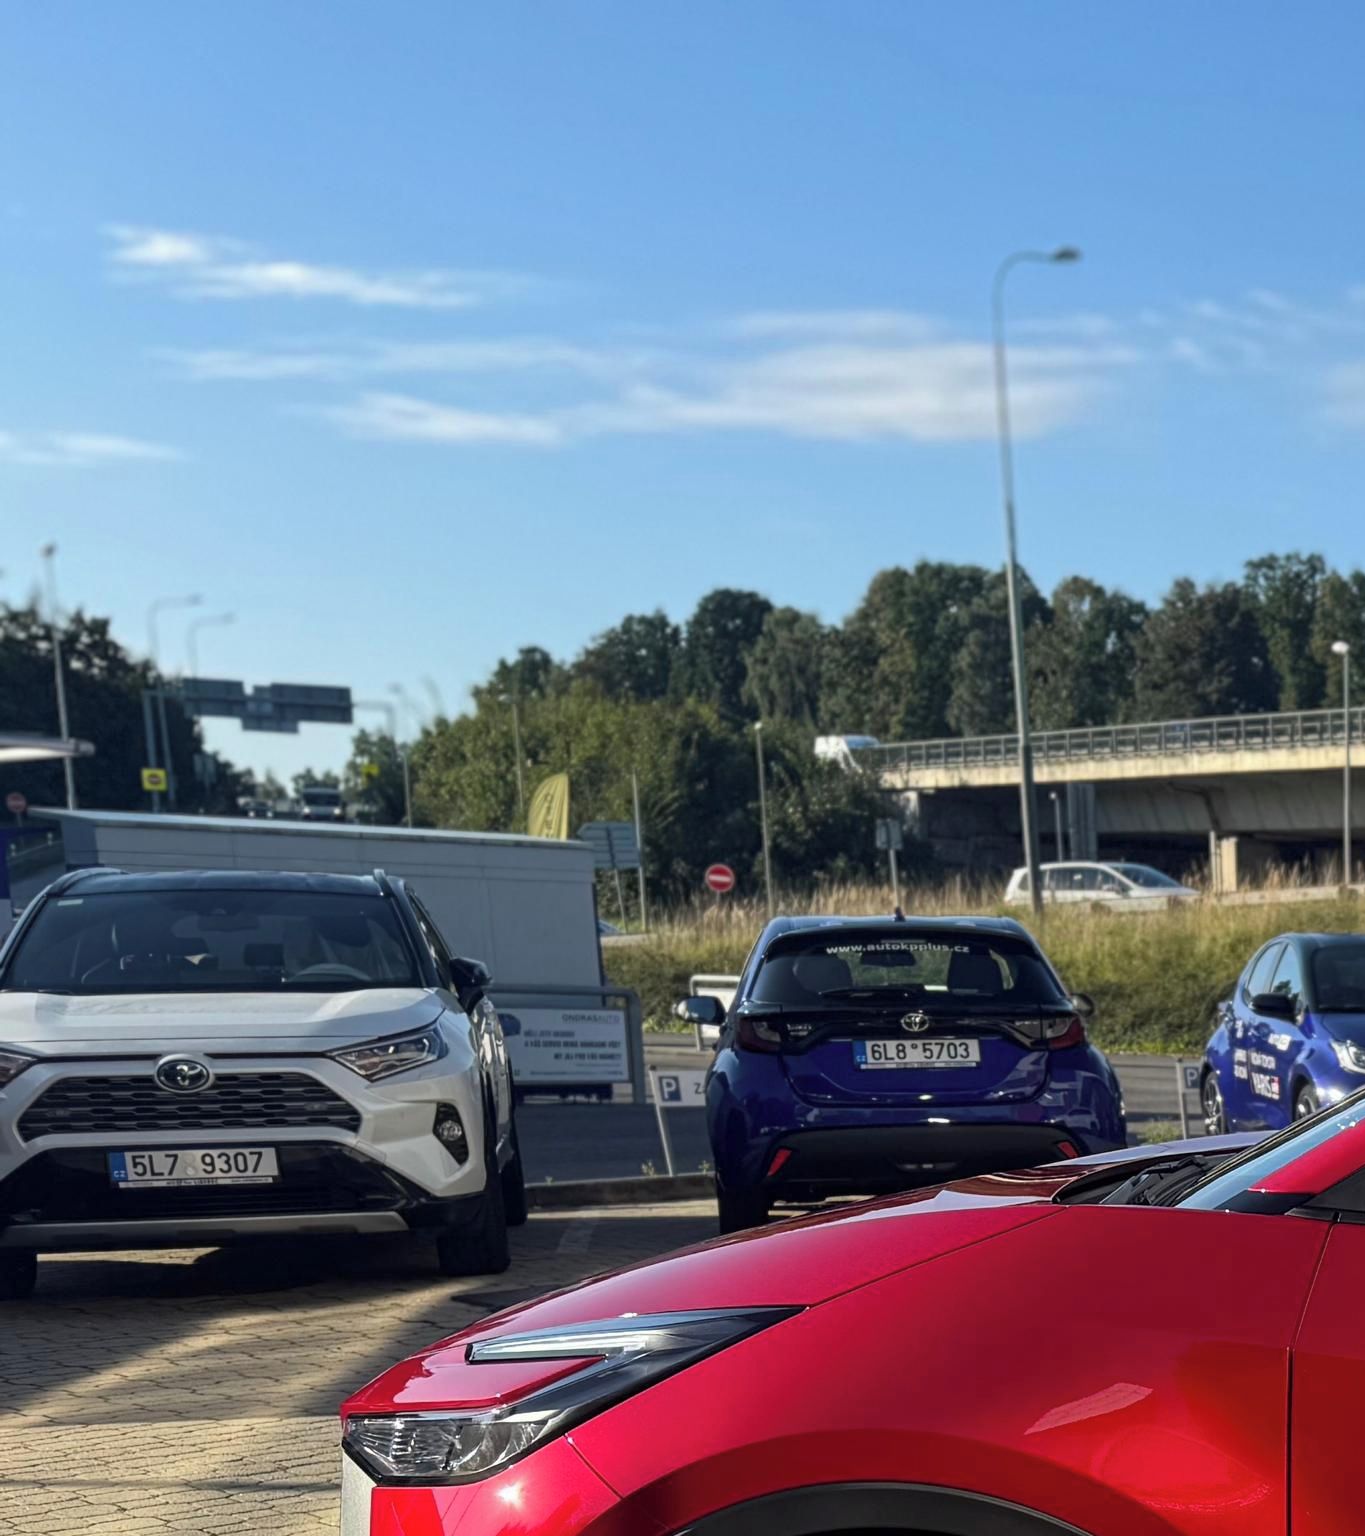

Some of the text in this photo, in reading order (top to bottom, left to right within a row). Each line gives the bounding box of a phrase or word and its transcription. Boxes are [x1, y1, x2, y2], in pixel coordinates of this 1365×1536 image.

[826, 942, 970, 954] www.autokpplus.cz
[871, 1041, 969, 1060] 6L8 5703
[662, 1077, 676, 1099] P
[131, 1151, 263, 1177] 5L7 9307
